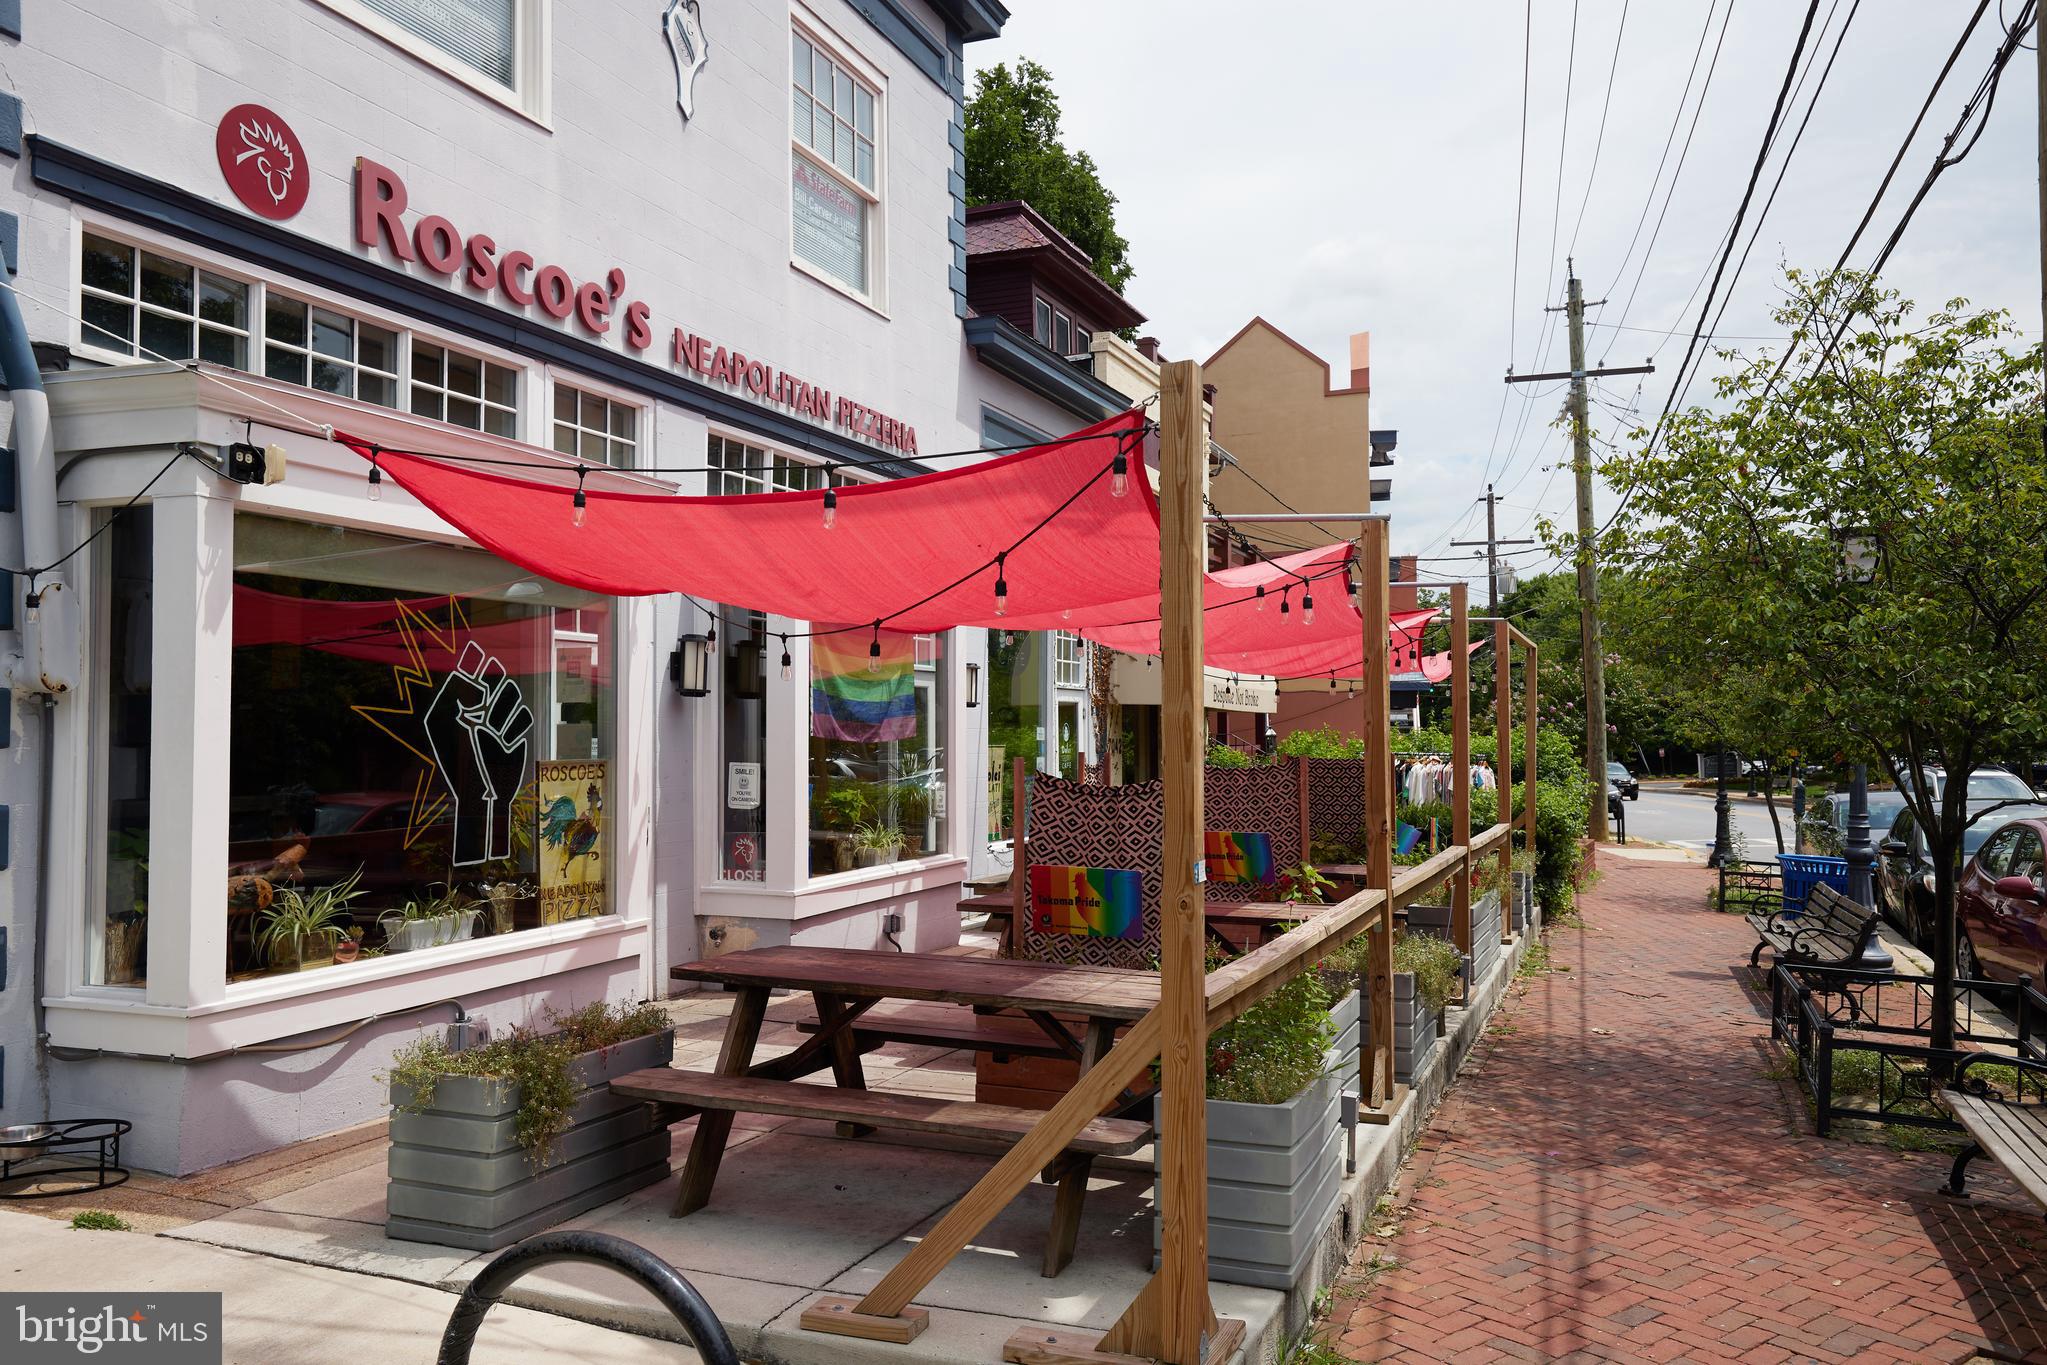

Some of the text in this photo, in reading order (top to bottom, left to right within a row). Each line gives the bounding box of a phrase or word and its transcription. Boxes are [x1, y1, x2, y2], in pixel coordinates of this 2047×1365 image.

[355, 155, 919, 456] Roscoe's NEAPOLITAN PIZZERIA
[541, 763, 605, 783] ROSCOE'S
[735, 768, 755, 776] SMILE!
[543, 892, 604, 928] PIZZA
[1038, 895, 1101, 908] Takoma Pride
